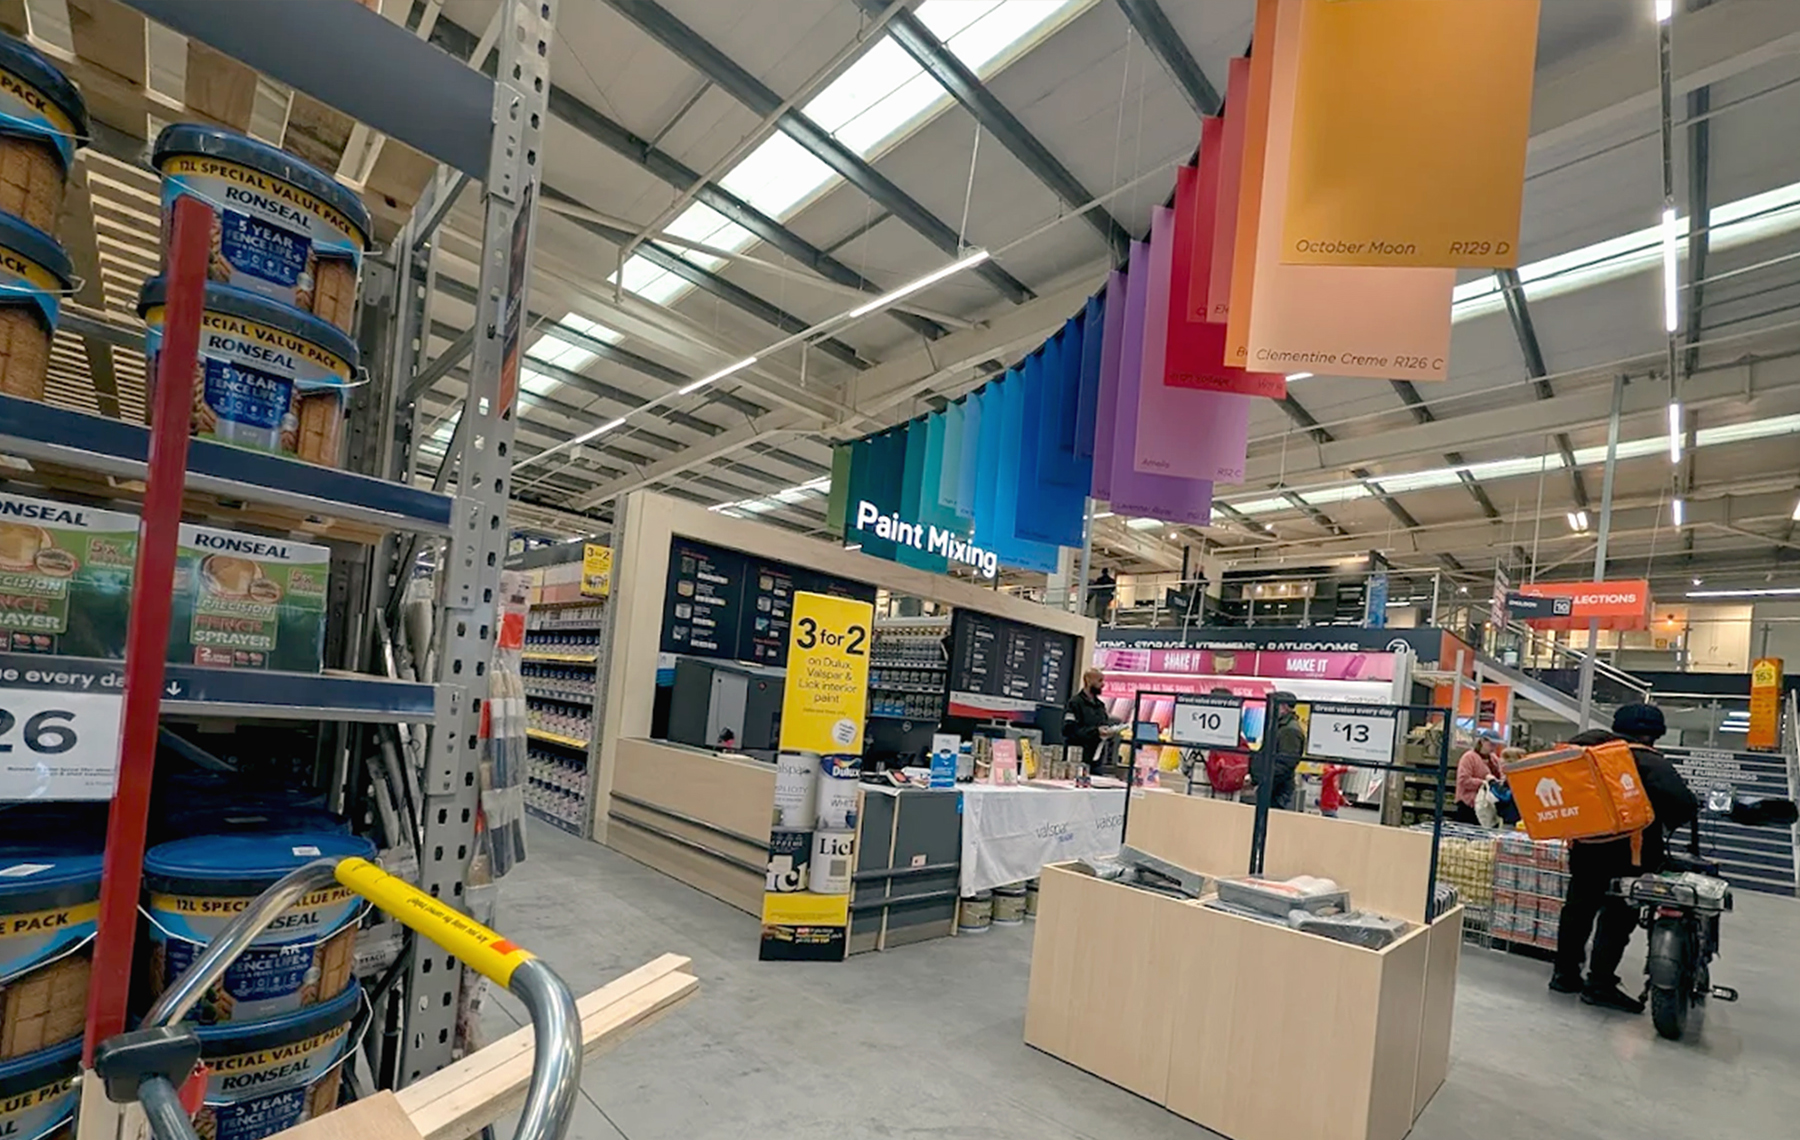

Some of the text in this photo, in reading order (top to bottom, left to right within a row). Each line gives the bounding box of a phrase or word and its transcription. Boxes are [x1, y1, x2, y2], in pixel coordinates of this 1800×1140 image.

[0, 76, 47, 113] PACK
[201, 159, 266, 190] SPECIAL
[271, 182, 321, 214] VALUE
[323, 208, 351, 234] PACK
[225, 186, 312, 229] RONSEAL
[238, 219, 294, 249] 5 YEAR
[1295, 239, 1416, 255] October Moon
[1449, 241, 1510, 255] R129 D
[203, 316, 337, 369] ECIAL VALUE PACK
[208, 335, 296, 370] RONSEAL
[1256, 348, 1336, 365] Clementine
[1341, 353, 1388, 367] Creme
[1393, 356, 1428, 369] R126
[1432, 358, 1444, 370] C
[222, 367, 277, 391] 5 YEAR
[0, 501, 88, 526] NSEAL
[194, 533, 290, 559] RONSEAL
[857, 500, 997, 578] Paint Mixing
[587, 547, 594, 557] 3
[602, 550, 609, 560] 2
[194, 630, 271, 647] SPRAYER
[796, 617, 866, 656] 3 for 2
[808, 657, 822, 666] on
[1164, 652, 1201, 671] SHAKE IT
[1286, 658, 1328, 673] MAKE IT
[25, 670, 95, 689] every
[100, 672, 128, 688] da
[807, 667, 843, 682] Valspar
[798, 678, 858, 693] Lick interior
[814, 693, 840, 704] paint
[1314, 704, 1394, 717] Great value every day
[1191, 712, 1221, 730] £10
[1333, 722, 1370, 743] £13
[832, 766, 860, 779] Dulux
[1096, 811, 1123, 831] valspa
[1537, 806, 1580, 822] JUST EAT
[176, 900, 197, 911] 12L
[202, 900, 250, 913] SPECI
[14, 912, 70, 933] PACK
[205, 1052, 267, 1072] PECIAL
[272, 1040, 320, 1060] VALUE
[222, 1058, 311, 1090] RONSEAL
[38, 1080, 72, 1102] PAC
[251, 1093, 294, 1112] YEAR
